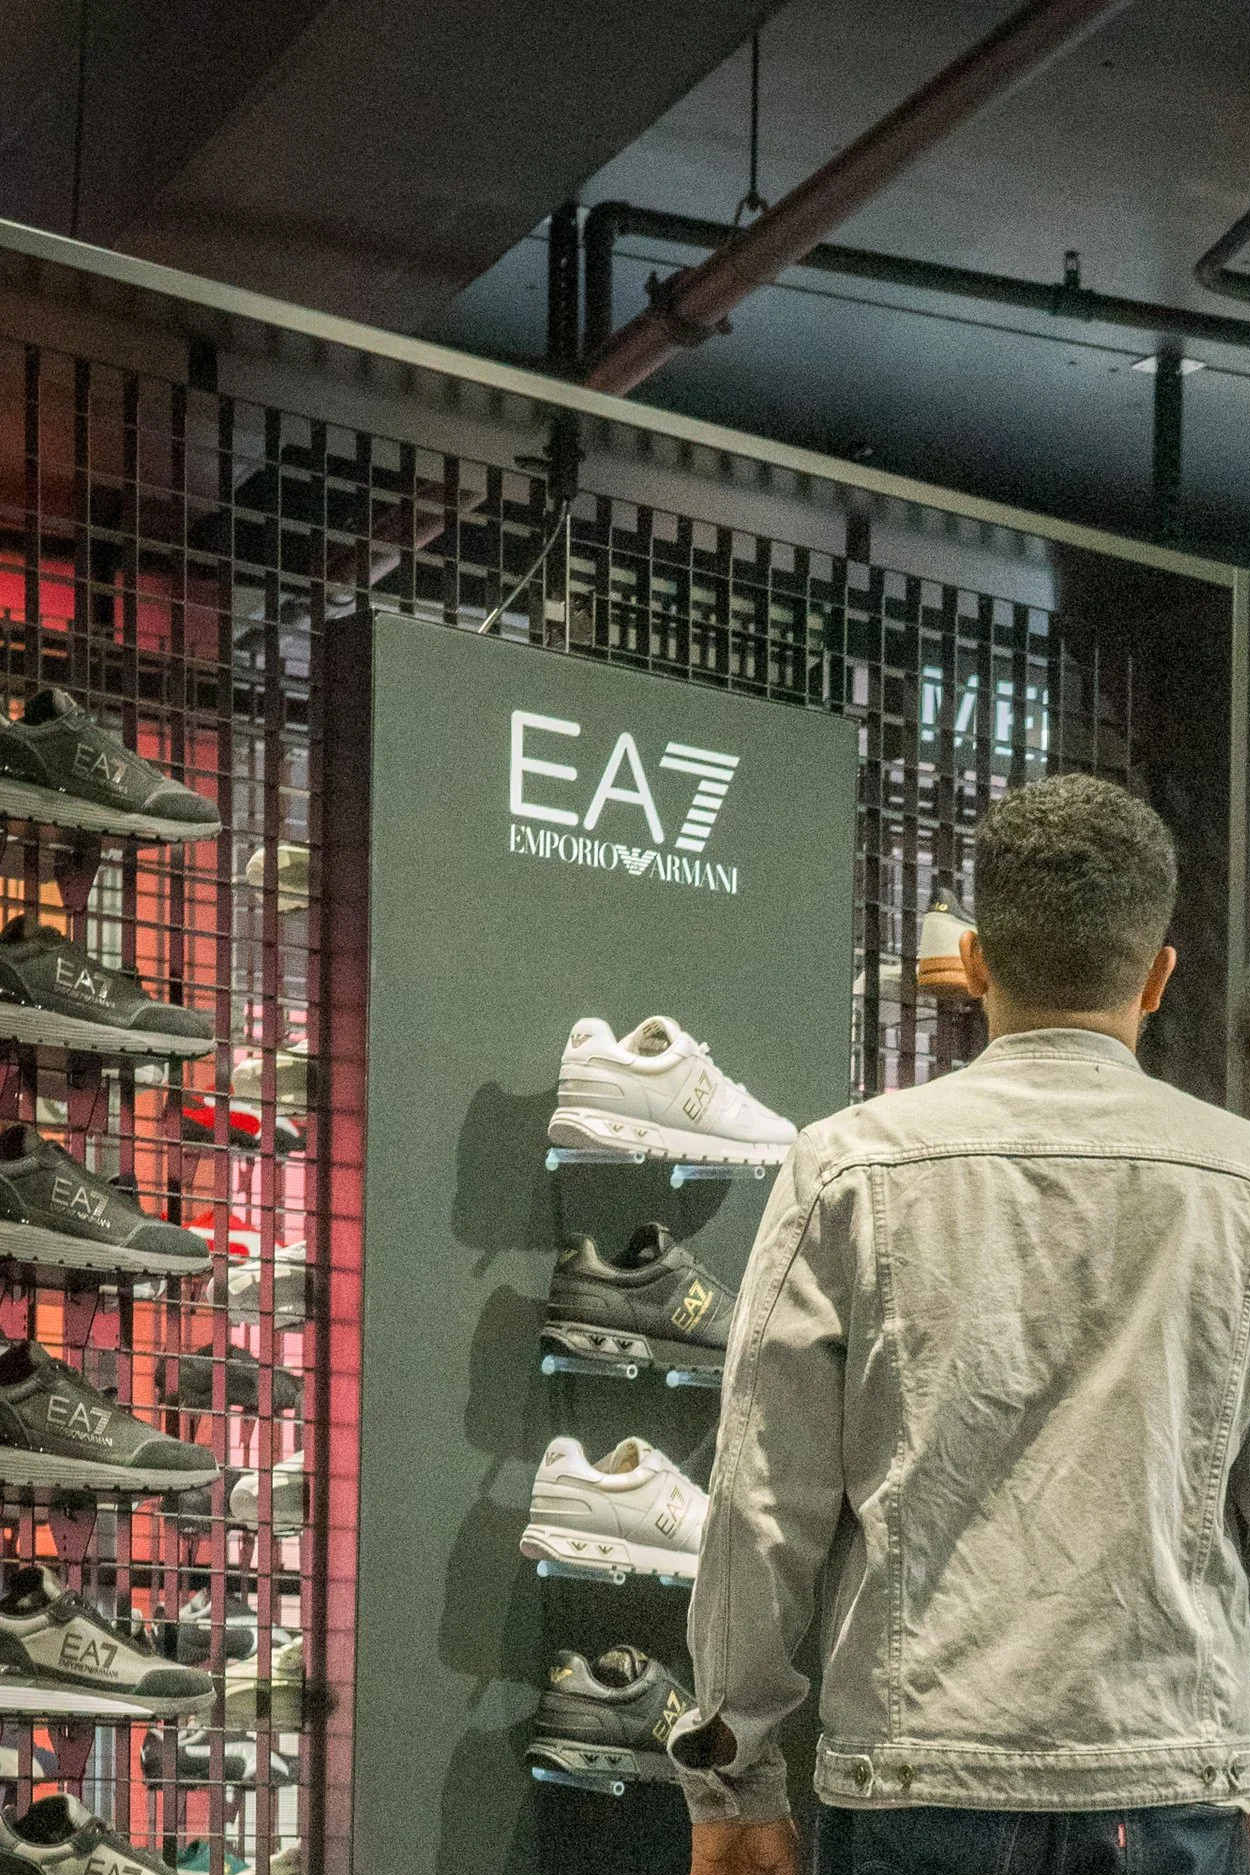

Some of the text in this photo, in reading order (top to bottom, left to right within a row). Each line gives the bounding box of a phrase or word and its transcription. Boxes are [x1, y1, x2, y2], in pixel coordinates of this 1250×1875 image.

[72, 742, 128, 785] EA7
[510, 709, 741, 853] EA7
[510, 823, 738, 895] EMPORIO ARMANI
[56, 957, 113, 999] EA7
[682, 1069, 713, 1121] EA7
[51, 1176, 110, 1218] EA7
[671, 1279, 708, 1331] EA7
[46, 1395, 113, 1436] EA7
[654, 1485, 687, 1536] EA7
[59, 1631, 119, 1670] EA7
[651, 1689, 682, 1741] EA7
